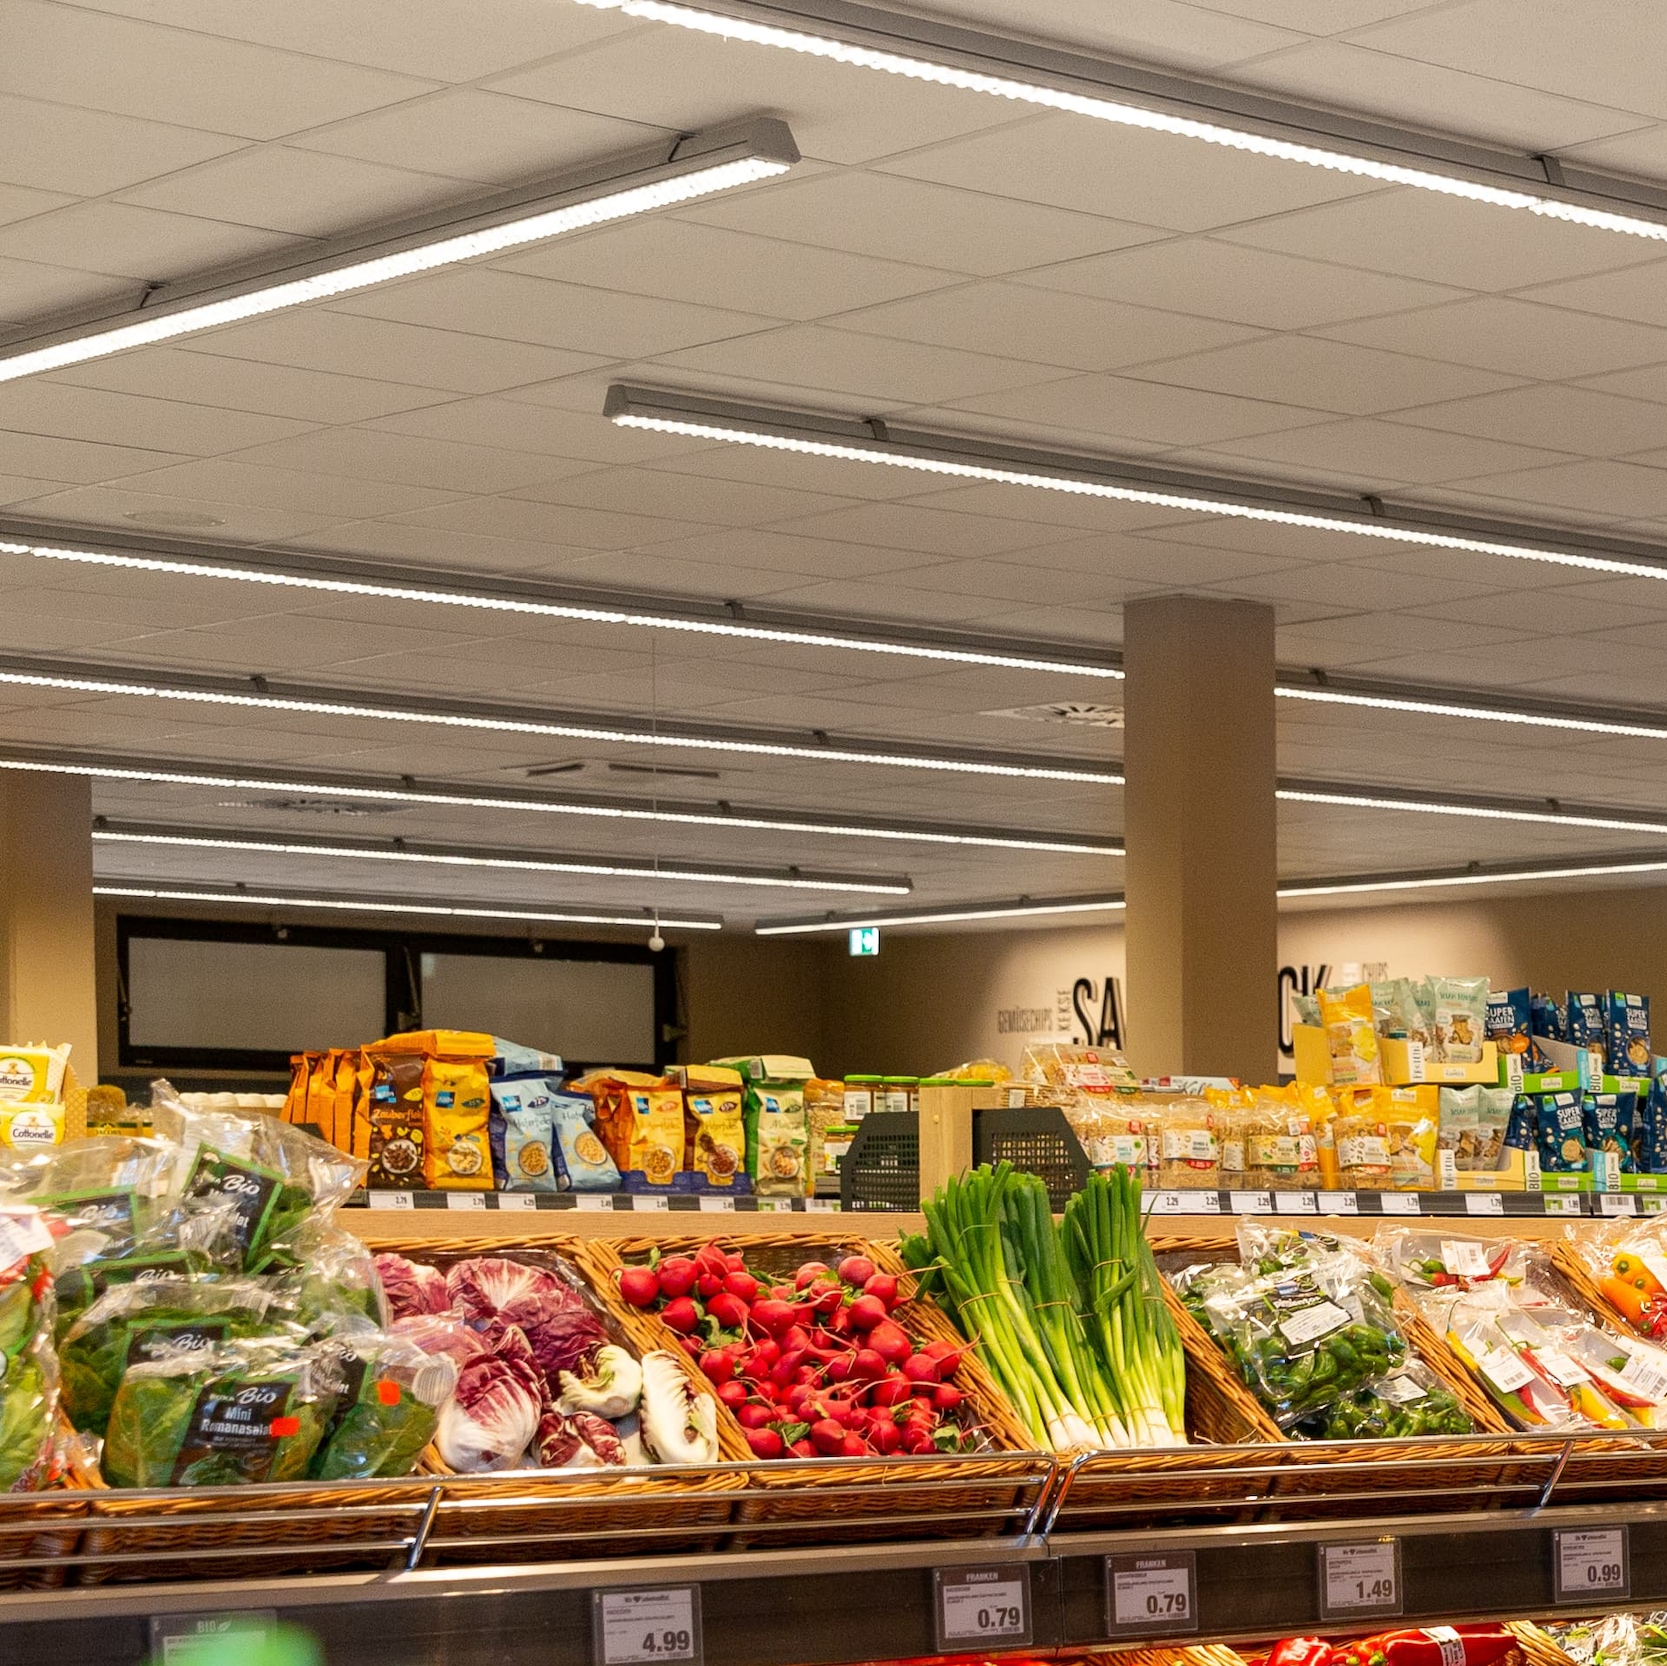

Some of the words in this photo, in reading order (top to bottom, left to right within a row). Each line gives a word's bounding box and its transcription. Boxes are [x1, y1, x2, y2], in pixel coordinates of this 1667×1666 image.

[1057, 988, 1072, 1032] KEKSE
[0, 1073, 33, 1088] ottonelle
[12, 1127, 54, 1141] Cottonelle
[223, 1174, 261, 1196] Bio
[171, 1332, 213, 1352] Bio
[236, 1386, 277, 1405] Bio
[224, 1407, 252, 1421] Mini
[1587, 1563, 1621, 1583] 0.99
[1355, 1578, 1393, 1599] 1.49
[1146, 1593, 1187, 1614] 0.79
[197, 1620, 216, 1633] BIO
[977, 1606, 1020, 1629] 0.79
[642, 1630, 690, 1653] 4.99
